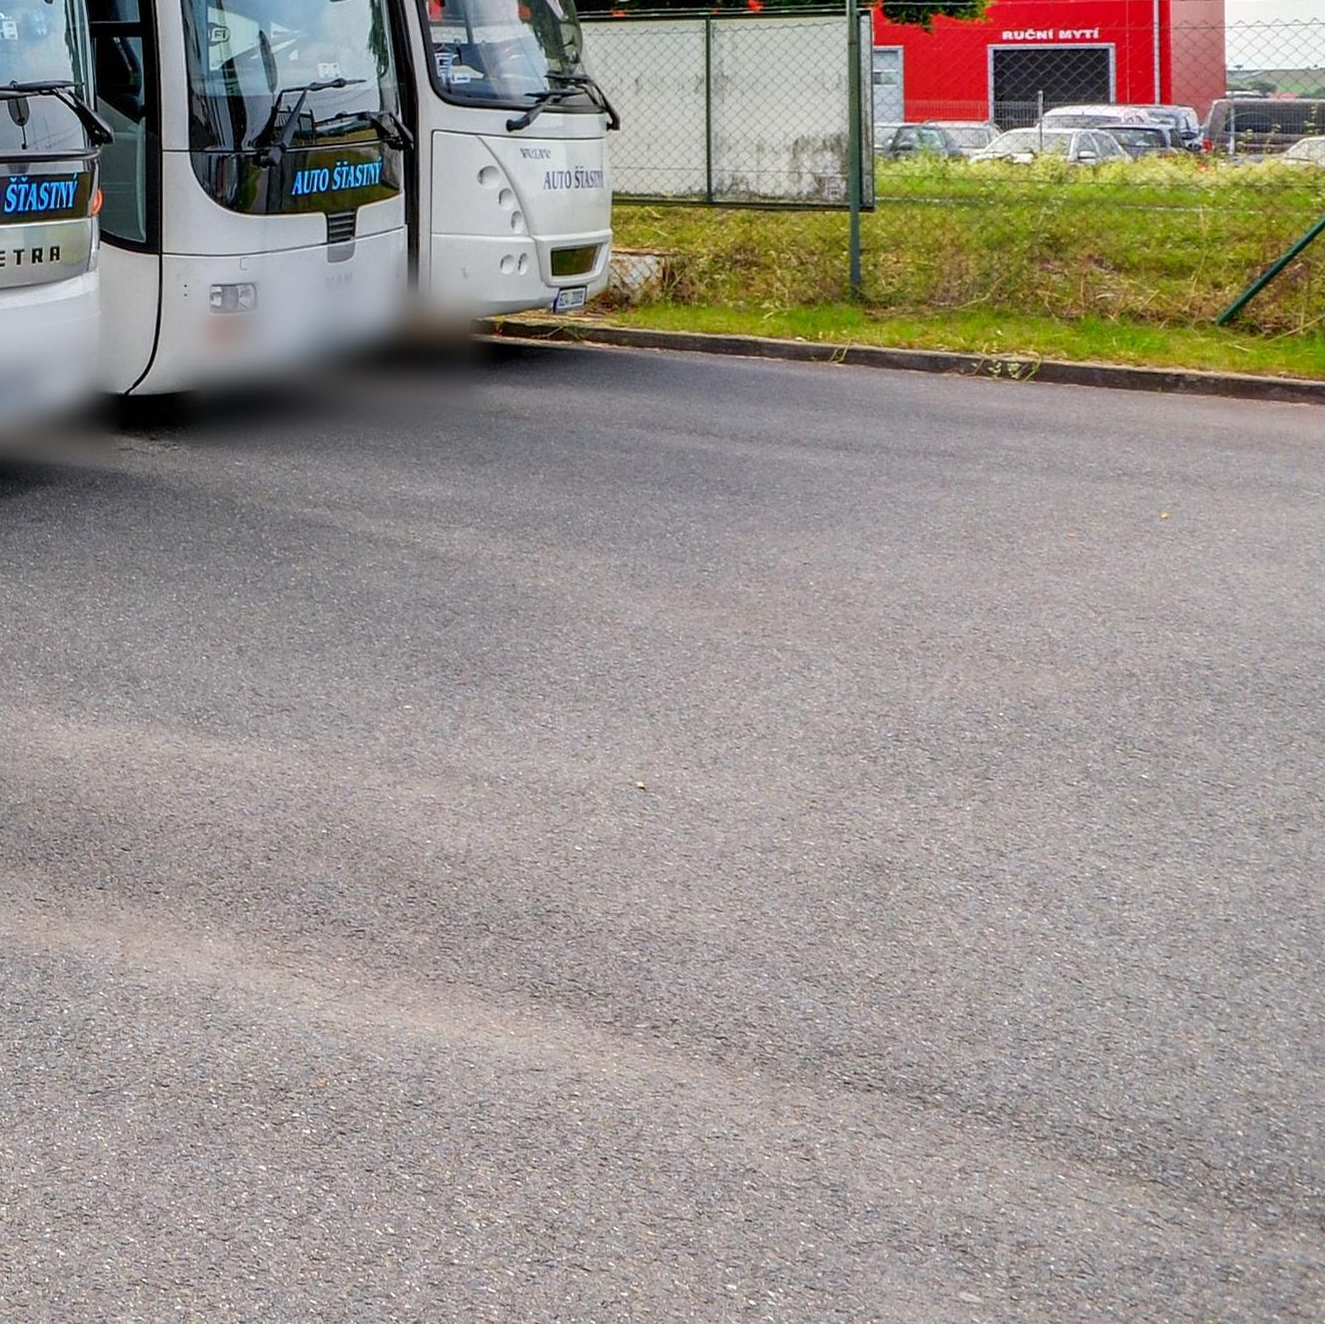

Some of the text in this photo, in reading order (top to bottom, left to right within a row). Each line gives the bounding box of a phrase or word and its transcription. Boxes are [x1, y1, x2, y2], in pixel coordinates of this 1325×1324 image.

[1002, 27, 1100, 40] RUČNÍ MYTÍ
[291, 156, 383, 195] AUTO ŠŤASTNÝ
[543, 170, 572, 190] AUTO
[4, 172, 78, 213] ŠŤASTNÝ
